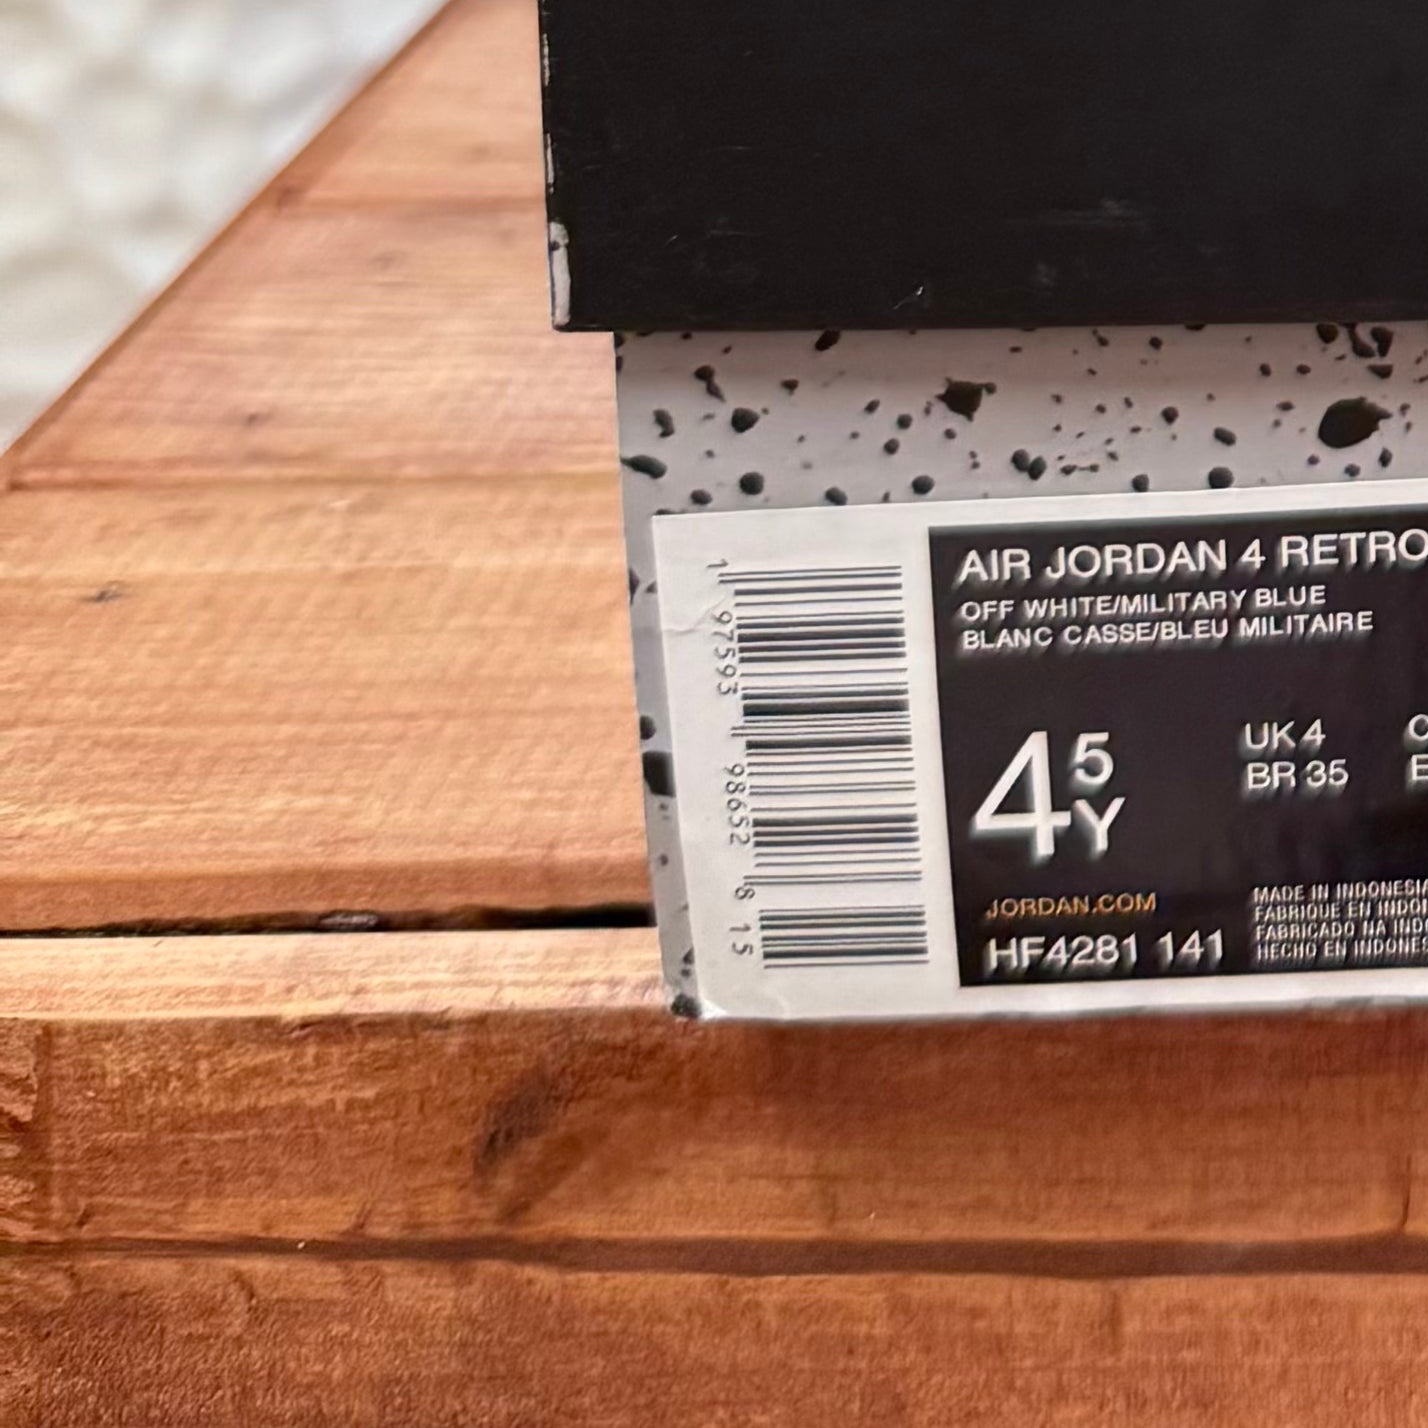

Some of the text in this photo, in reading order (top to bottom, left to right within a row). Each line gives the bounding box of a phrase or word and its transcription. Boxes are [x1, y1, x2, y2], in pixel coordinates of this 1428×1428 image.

[958, 546, 1032, 583] AIR
[1045, 538, 1227, 579] JORDAN
[1241, 539, 1266, 572] 4
[961, 584, 1326, 621] OFF WHITE/MILITARY BLUE
[963, 610, 1373, 650] BLANC CASSE/BLEU MILITAIRE
[1244, 719, 1326, 748] UK 4
[1072, 732, 1113, 784] 5
[1246, 759, 1348, 789] BR 35
[972, 731, 1071, 856] 4
[1074, 797, 1125, 851] Y
[986, 893, 1156, 918] JORDAN.COM
[1253, 884, 1305, 903] MADE
[1312, 883, 1329, 900] IN
[1348, 901, 1371, 918] EN
[1255, 921, 1355, 941] FABRICADO
[988, 928, 1223, 970] HF4281 141
[1257, 942, 1317, 961] HECHO
[1324, 940, 1347, 958] EN
